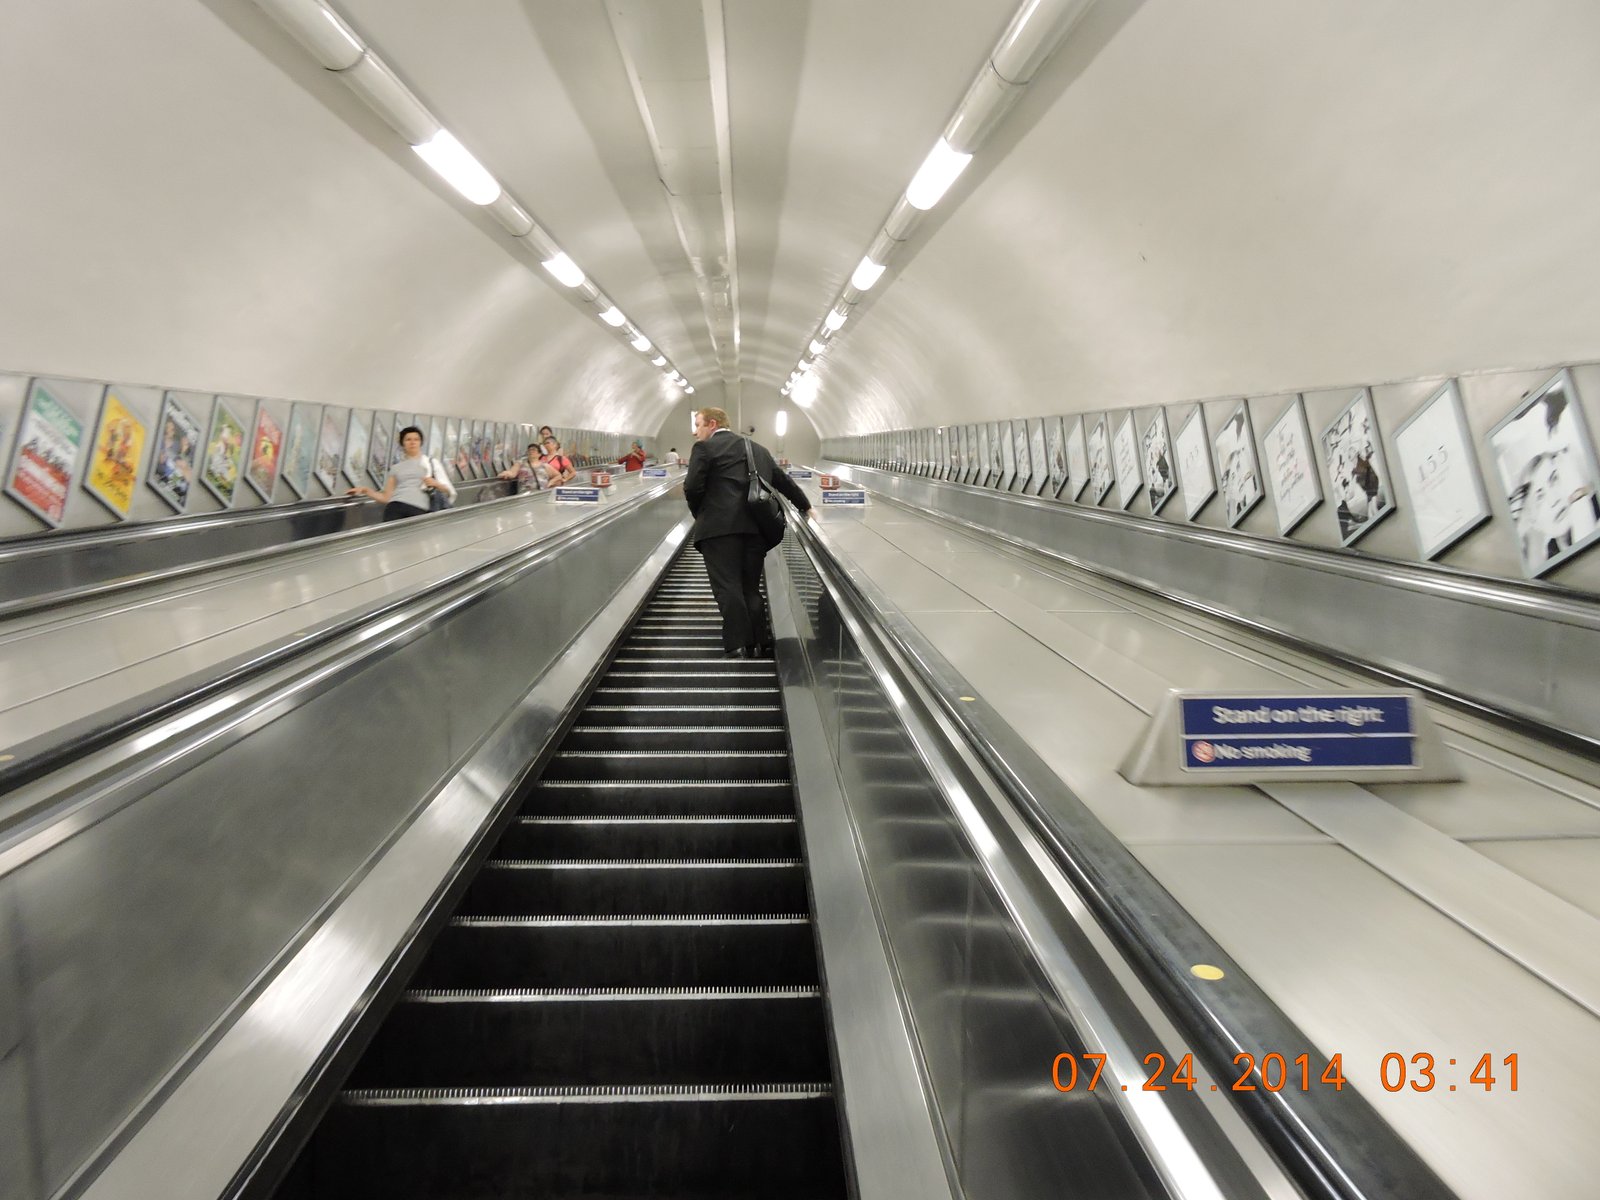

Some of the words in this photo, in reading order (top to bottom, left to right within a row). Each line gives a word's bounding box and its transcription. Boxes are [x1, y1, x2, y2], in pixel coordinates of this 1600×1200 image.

[1212, 705, 1271, 724] Stand
[1271, 709, 1299, 724] on
[1298, 706, 1334, 723] the
[1334, 706, 1384, 726] right
[1214, 743, 1242, 759] No
[1241, 744, 1312, 762] smoking
